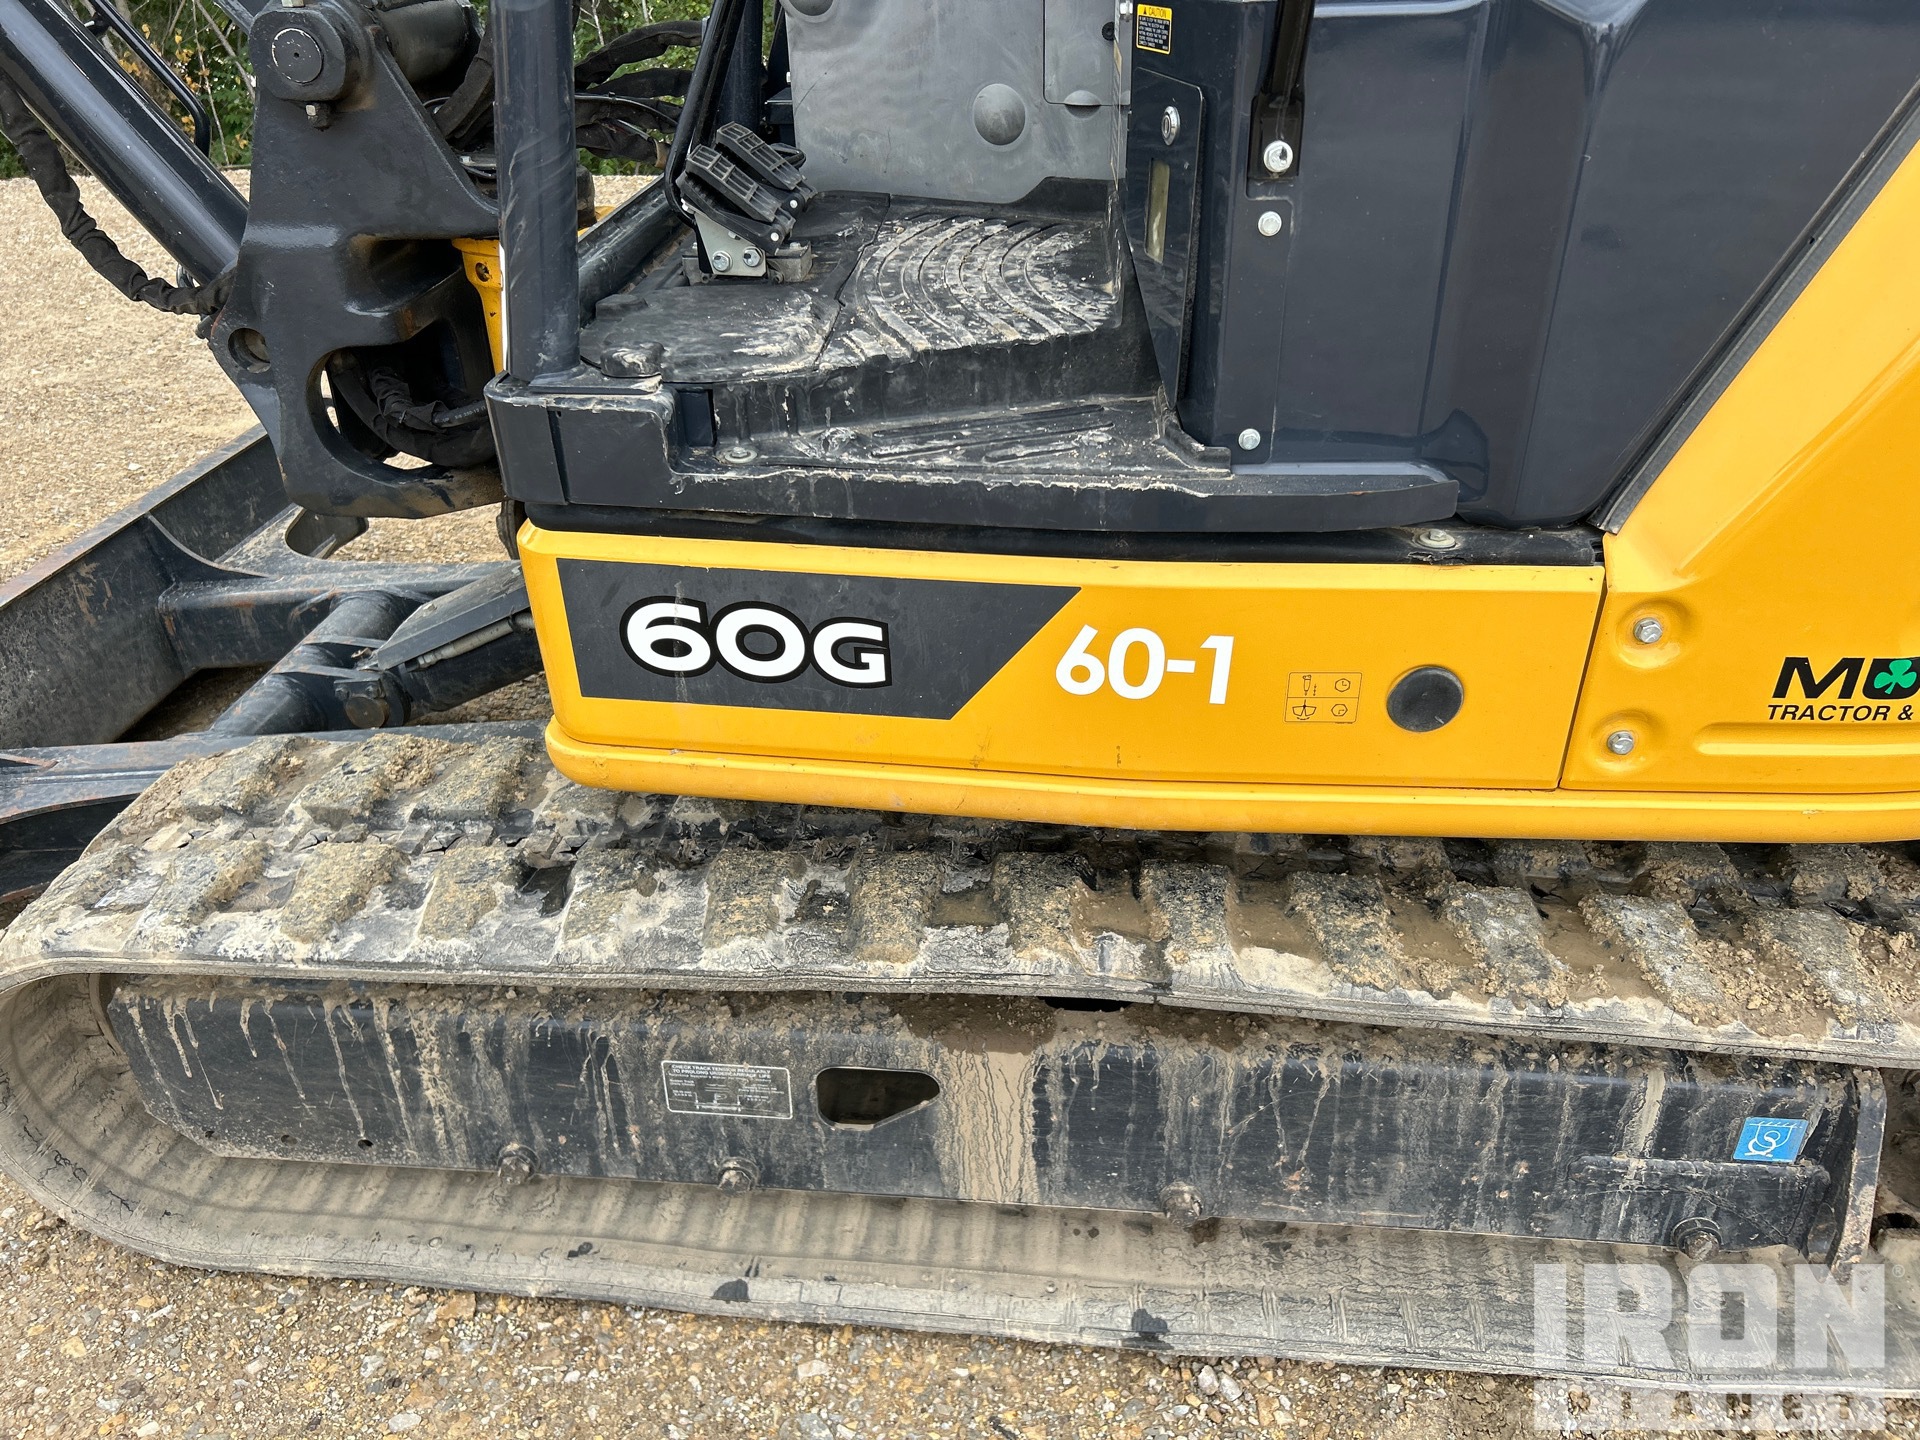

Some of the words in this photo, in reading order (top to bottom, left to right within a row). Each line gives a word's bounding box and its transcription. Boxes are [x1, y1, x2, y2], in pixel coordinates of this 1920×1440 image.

[619, 596, 893, 689] 60G
[1055, 623, 1234, 706] 60-1
[1767, 704, 1891, 721] TRACTOR
[1897, 704, 1914, 721] &
